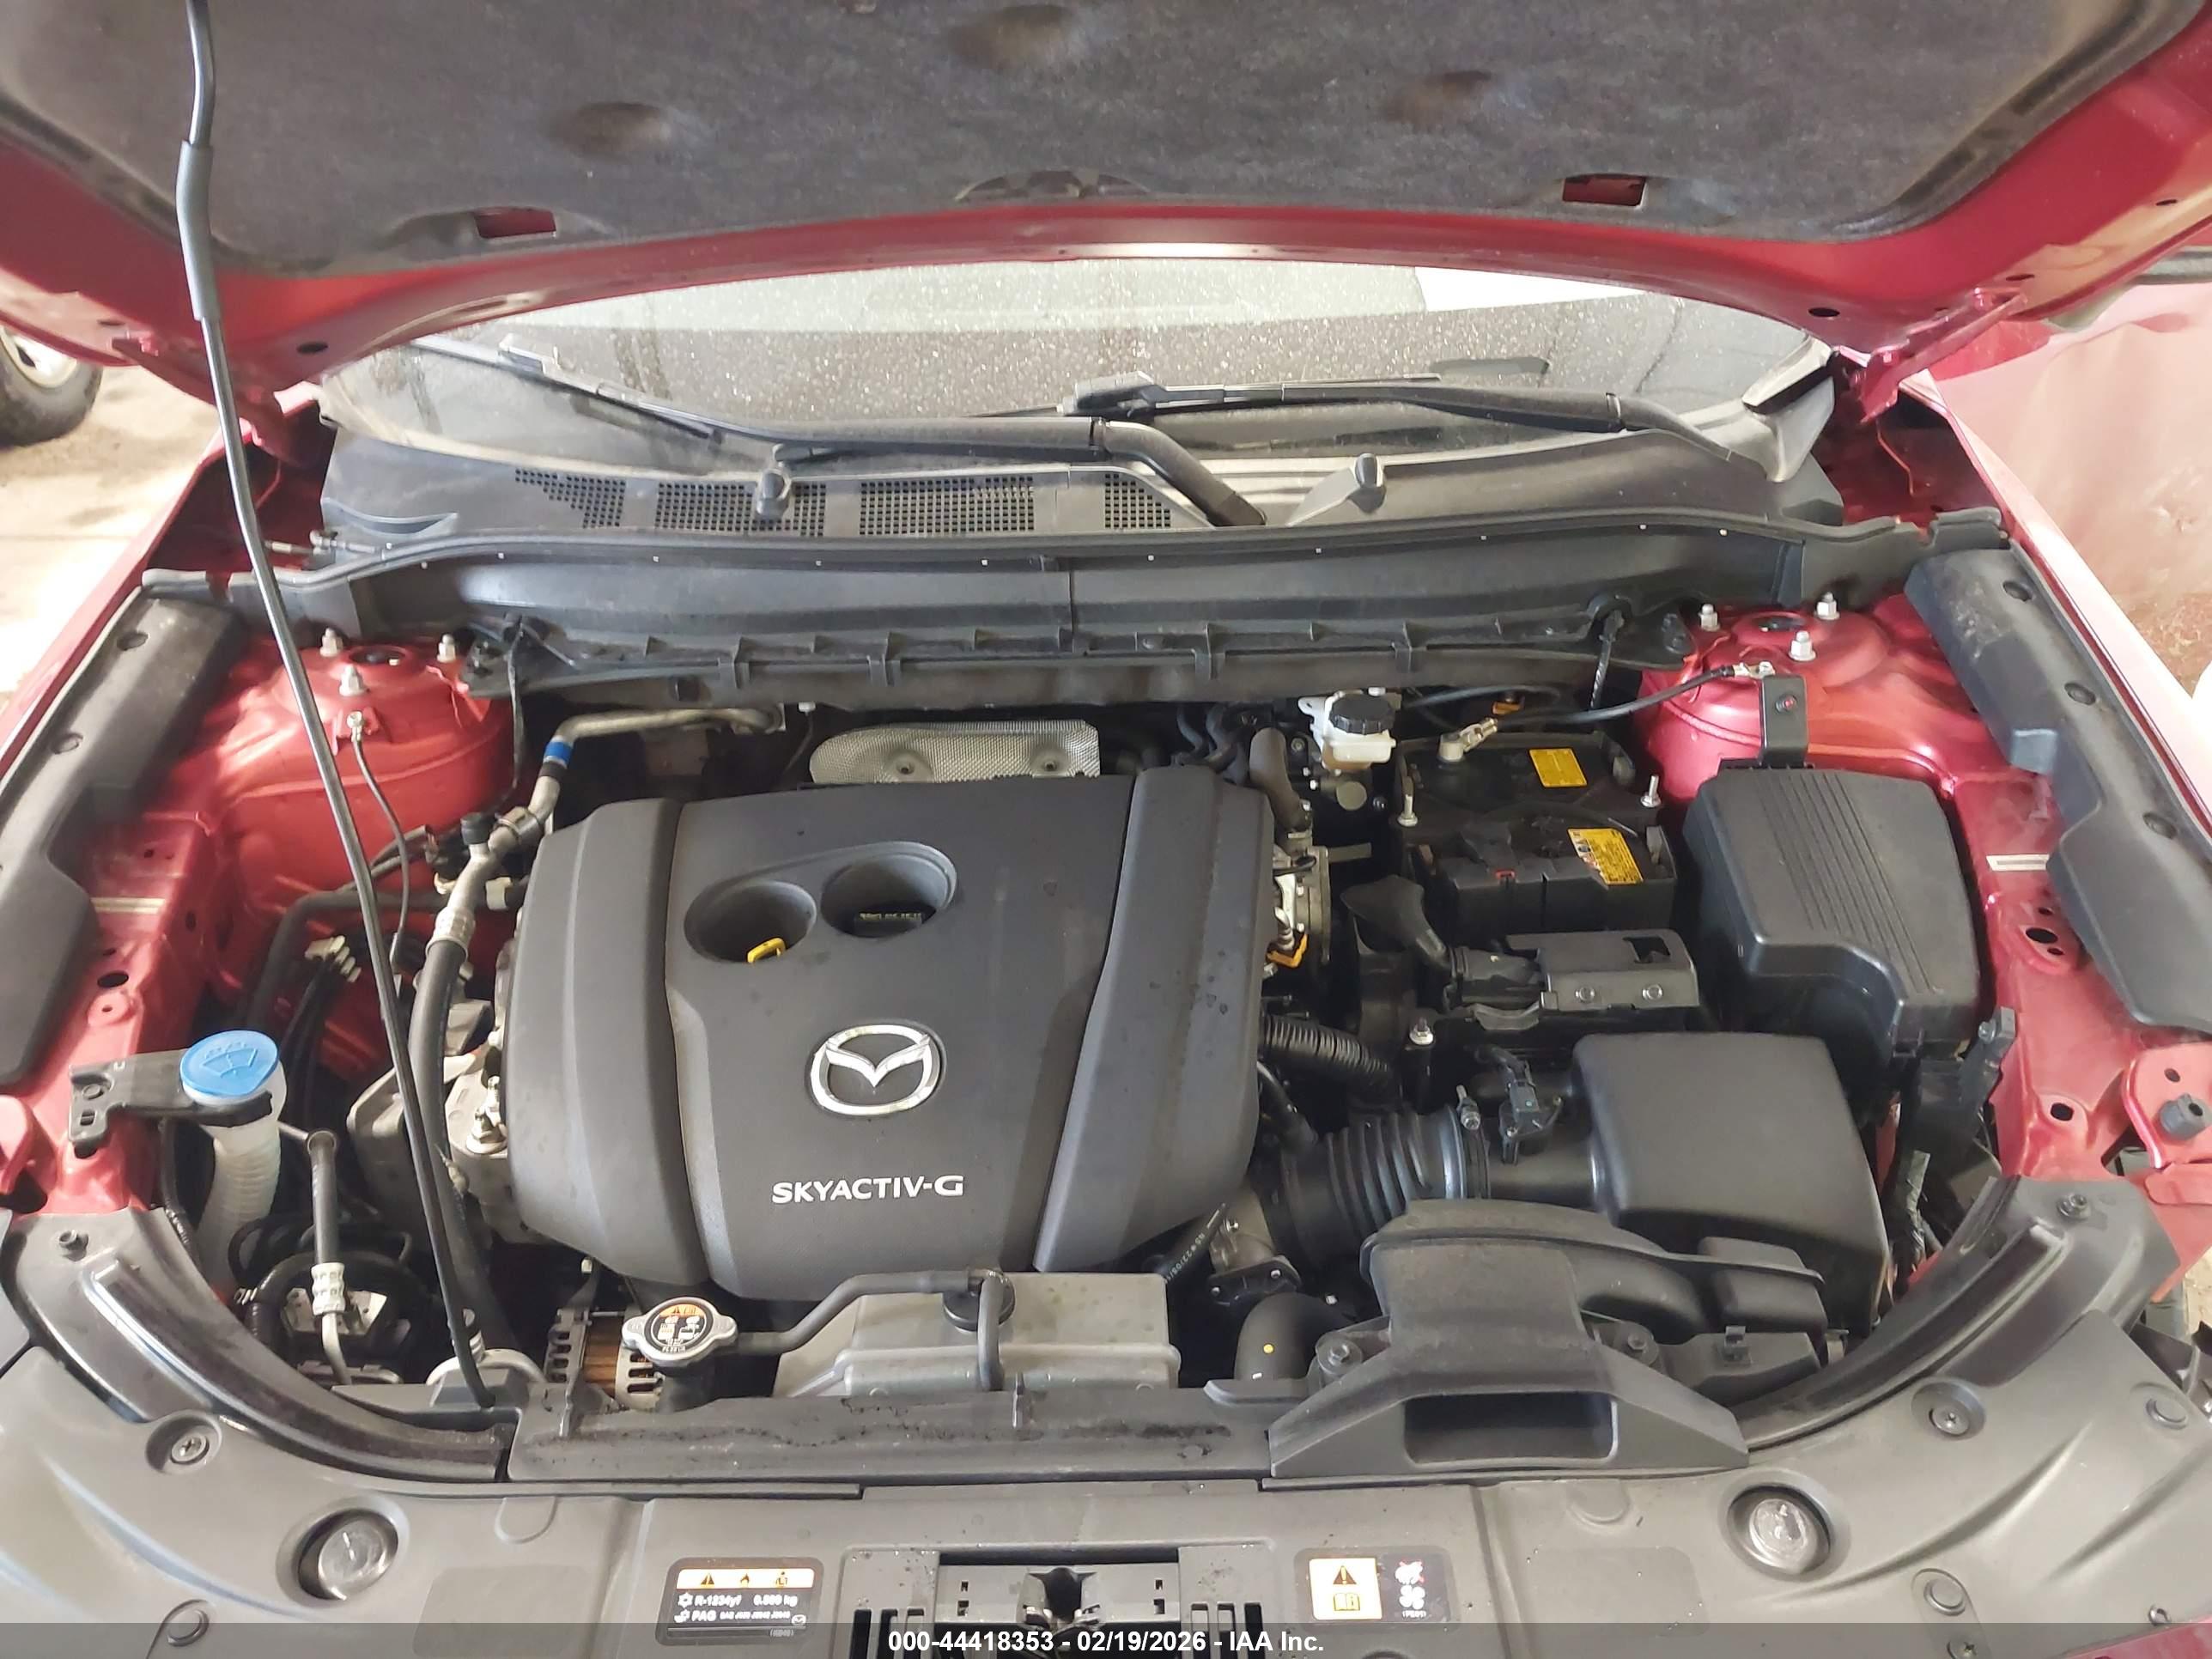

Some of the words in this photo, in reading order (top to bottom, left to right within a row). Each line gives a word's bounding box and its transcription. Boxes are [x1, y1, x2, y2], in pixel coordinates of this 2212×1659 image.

[772, 1175, 963, 1204] SKYACTIV-G
[783, 1595, 799, 1607] kg
[691, 1610, 717, 1622] PAG
